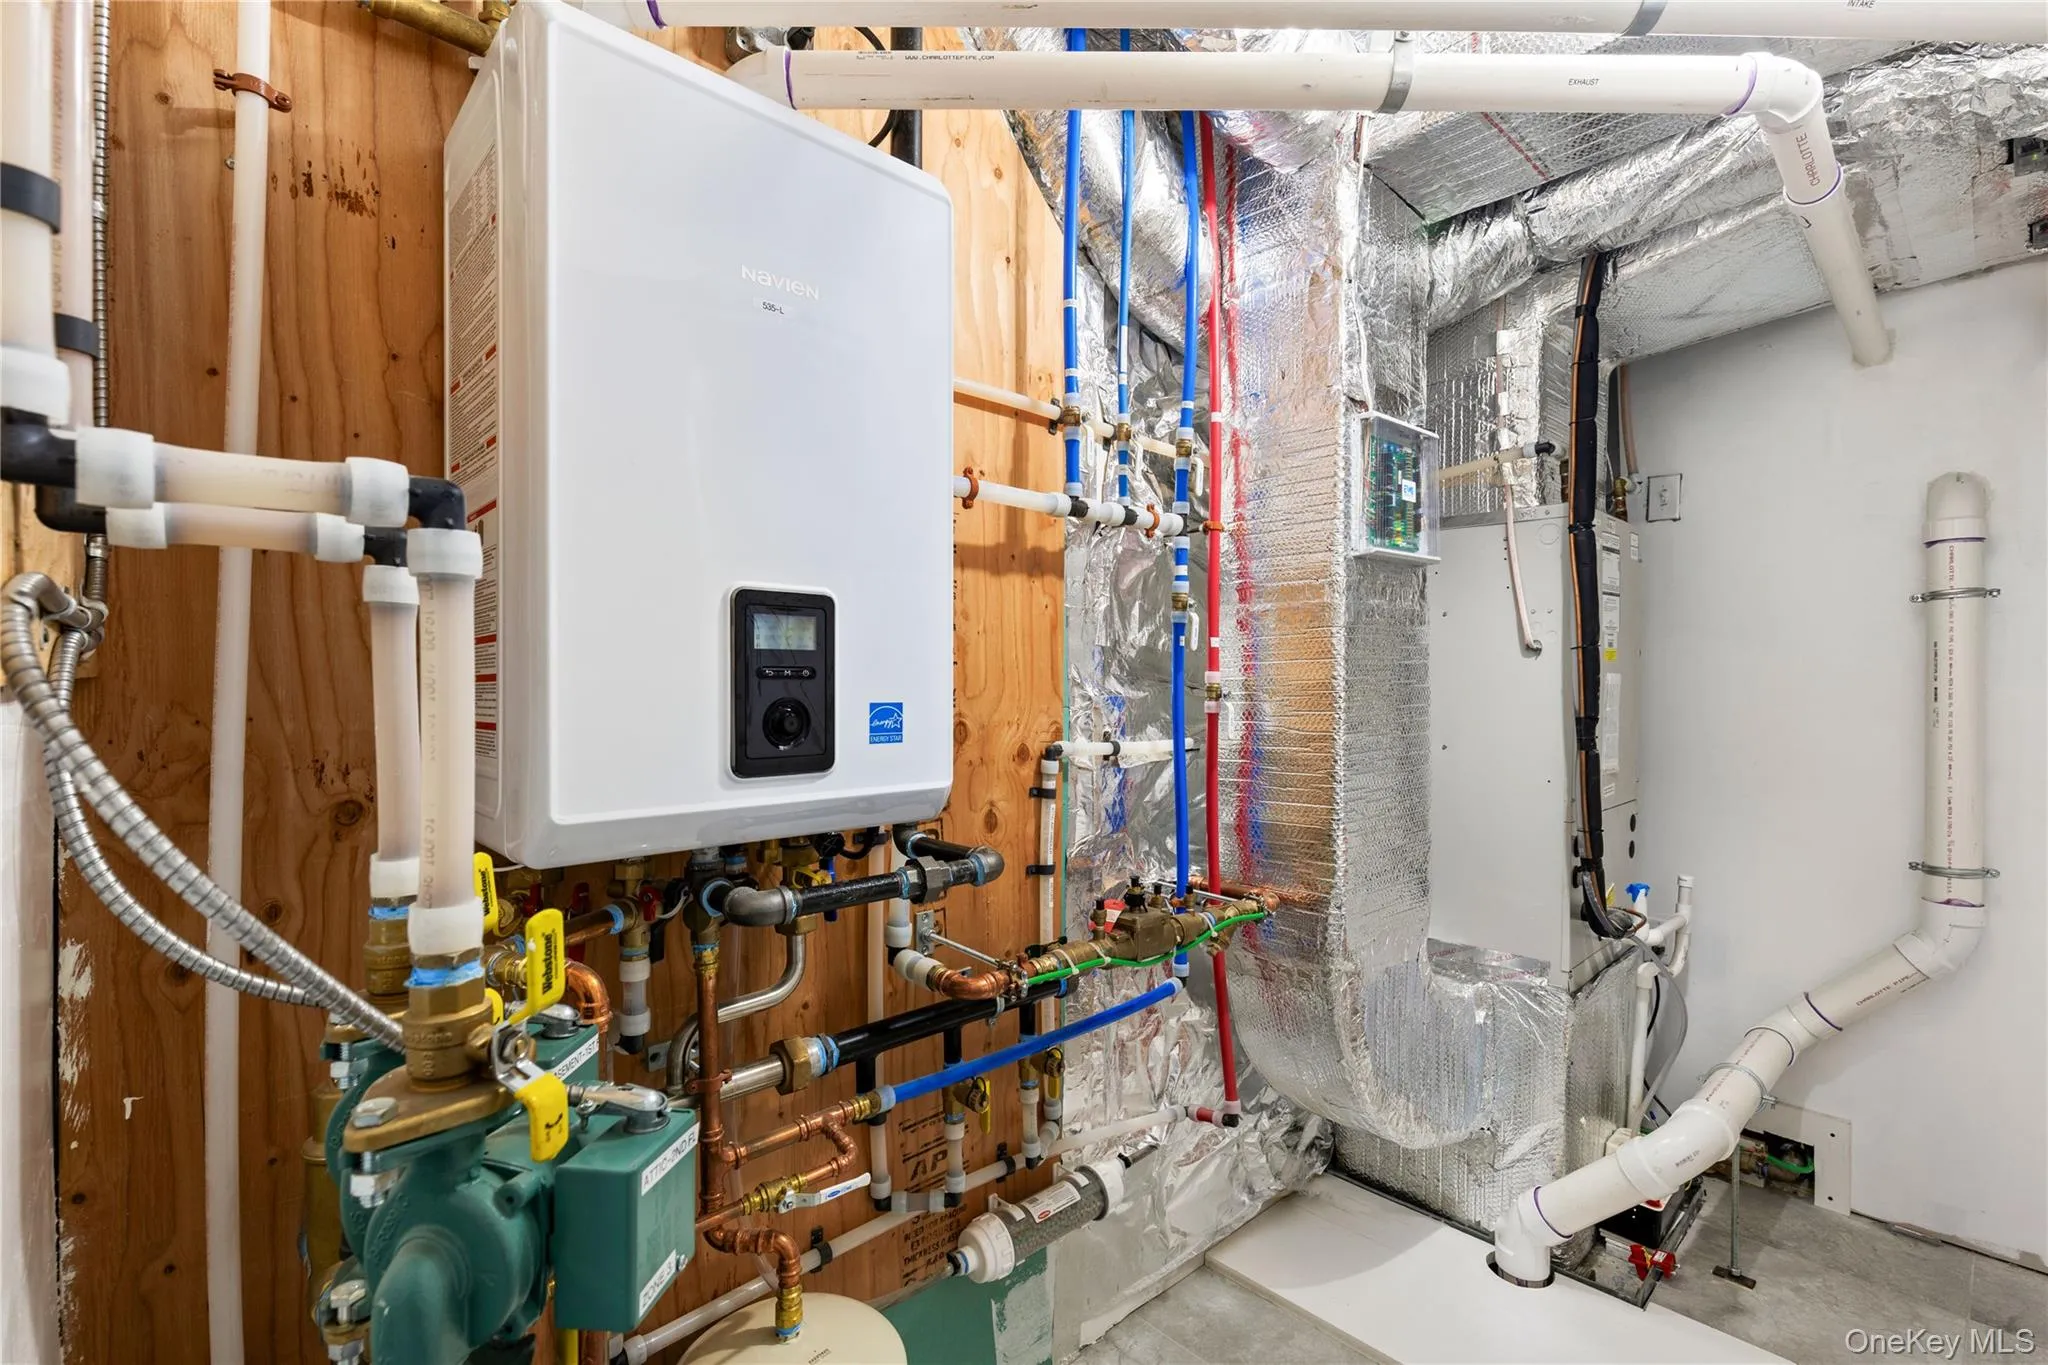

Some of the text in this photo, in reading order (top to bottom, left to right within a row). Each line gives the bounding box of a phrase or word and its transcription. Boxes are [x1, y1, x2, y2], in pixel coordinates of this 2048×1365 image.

[1568, 78, 1600, 86] EXHAUST
[1795, 131, 1821, 187] CHARLOTTE
[542, 933, 553, 995] Webstone
